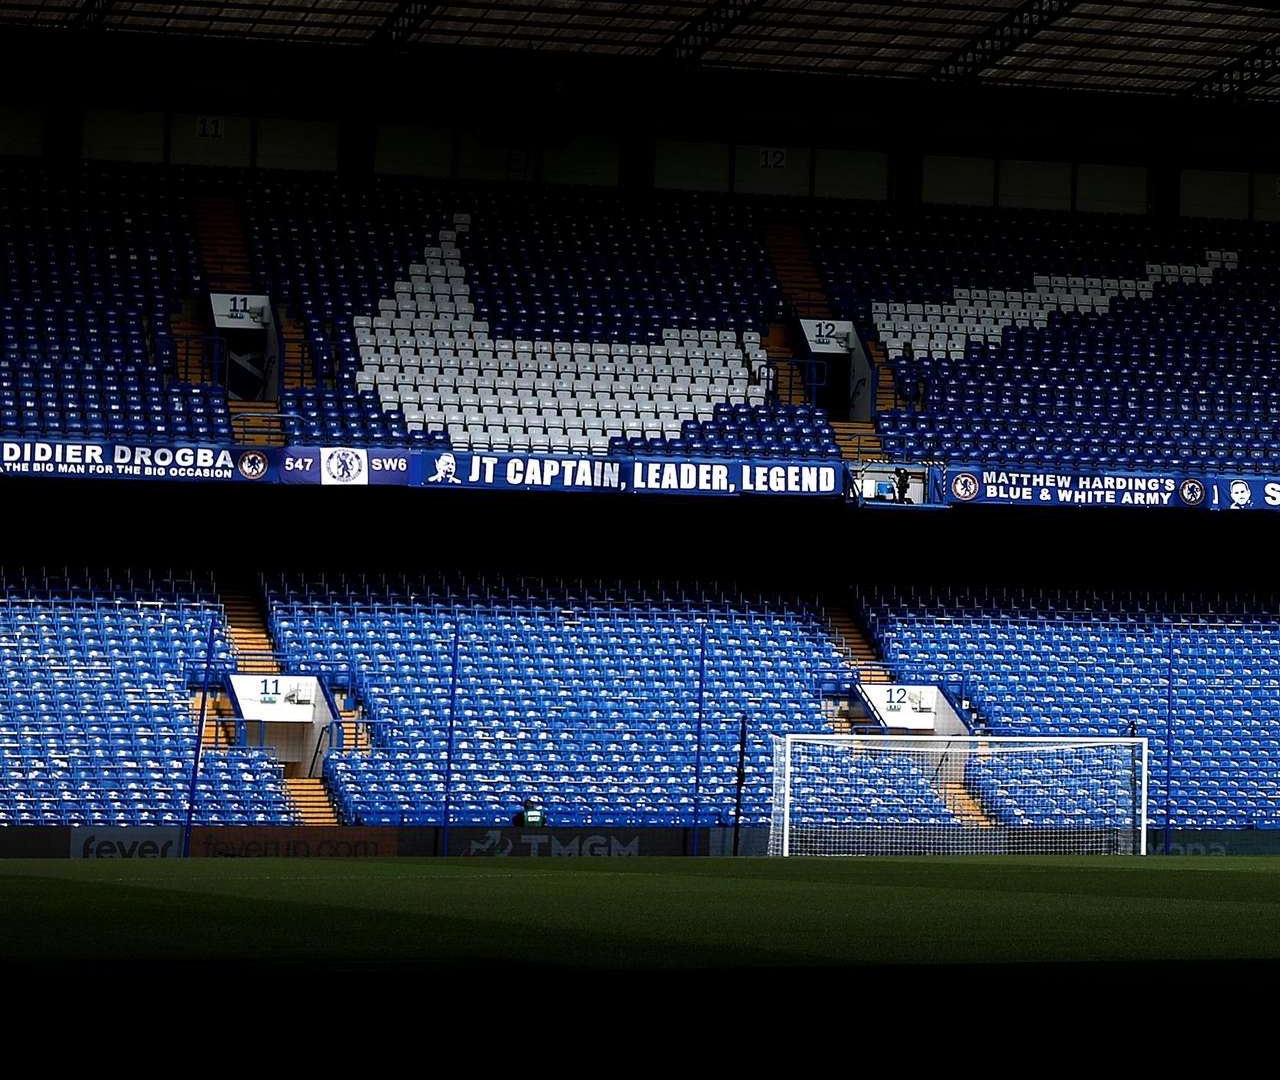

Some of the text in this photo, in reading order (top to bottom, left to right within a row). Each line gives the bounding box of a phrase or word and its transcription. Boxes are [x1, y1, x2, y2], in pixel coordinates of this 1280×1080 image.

[230, 297, 250, 313] 11
[815, 323, 835, 338] 12
[2, 442, 235, 469] DIDIER DROGBA
[4, 462, 233, 479] THE BIG MAN FOR THE BIG OCCASION
[285, 458, 313, 471] 547
[371, 458, 407, 472] SW6
[469, 456, 835, 494] JT CAPTAIN, LEADER, LEGEND
[983, 472, 1176, 492] MATTHEW HARDING'S
[987, 485, 1172, 505] BLUE & WHITE ARMY
[261, 679, 282, 695] 11
[886, 688, 906, 704] 12
[83, 835, 173, 857] fever
[521, 835, 640, 857] TMGM
